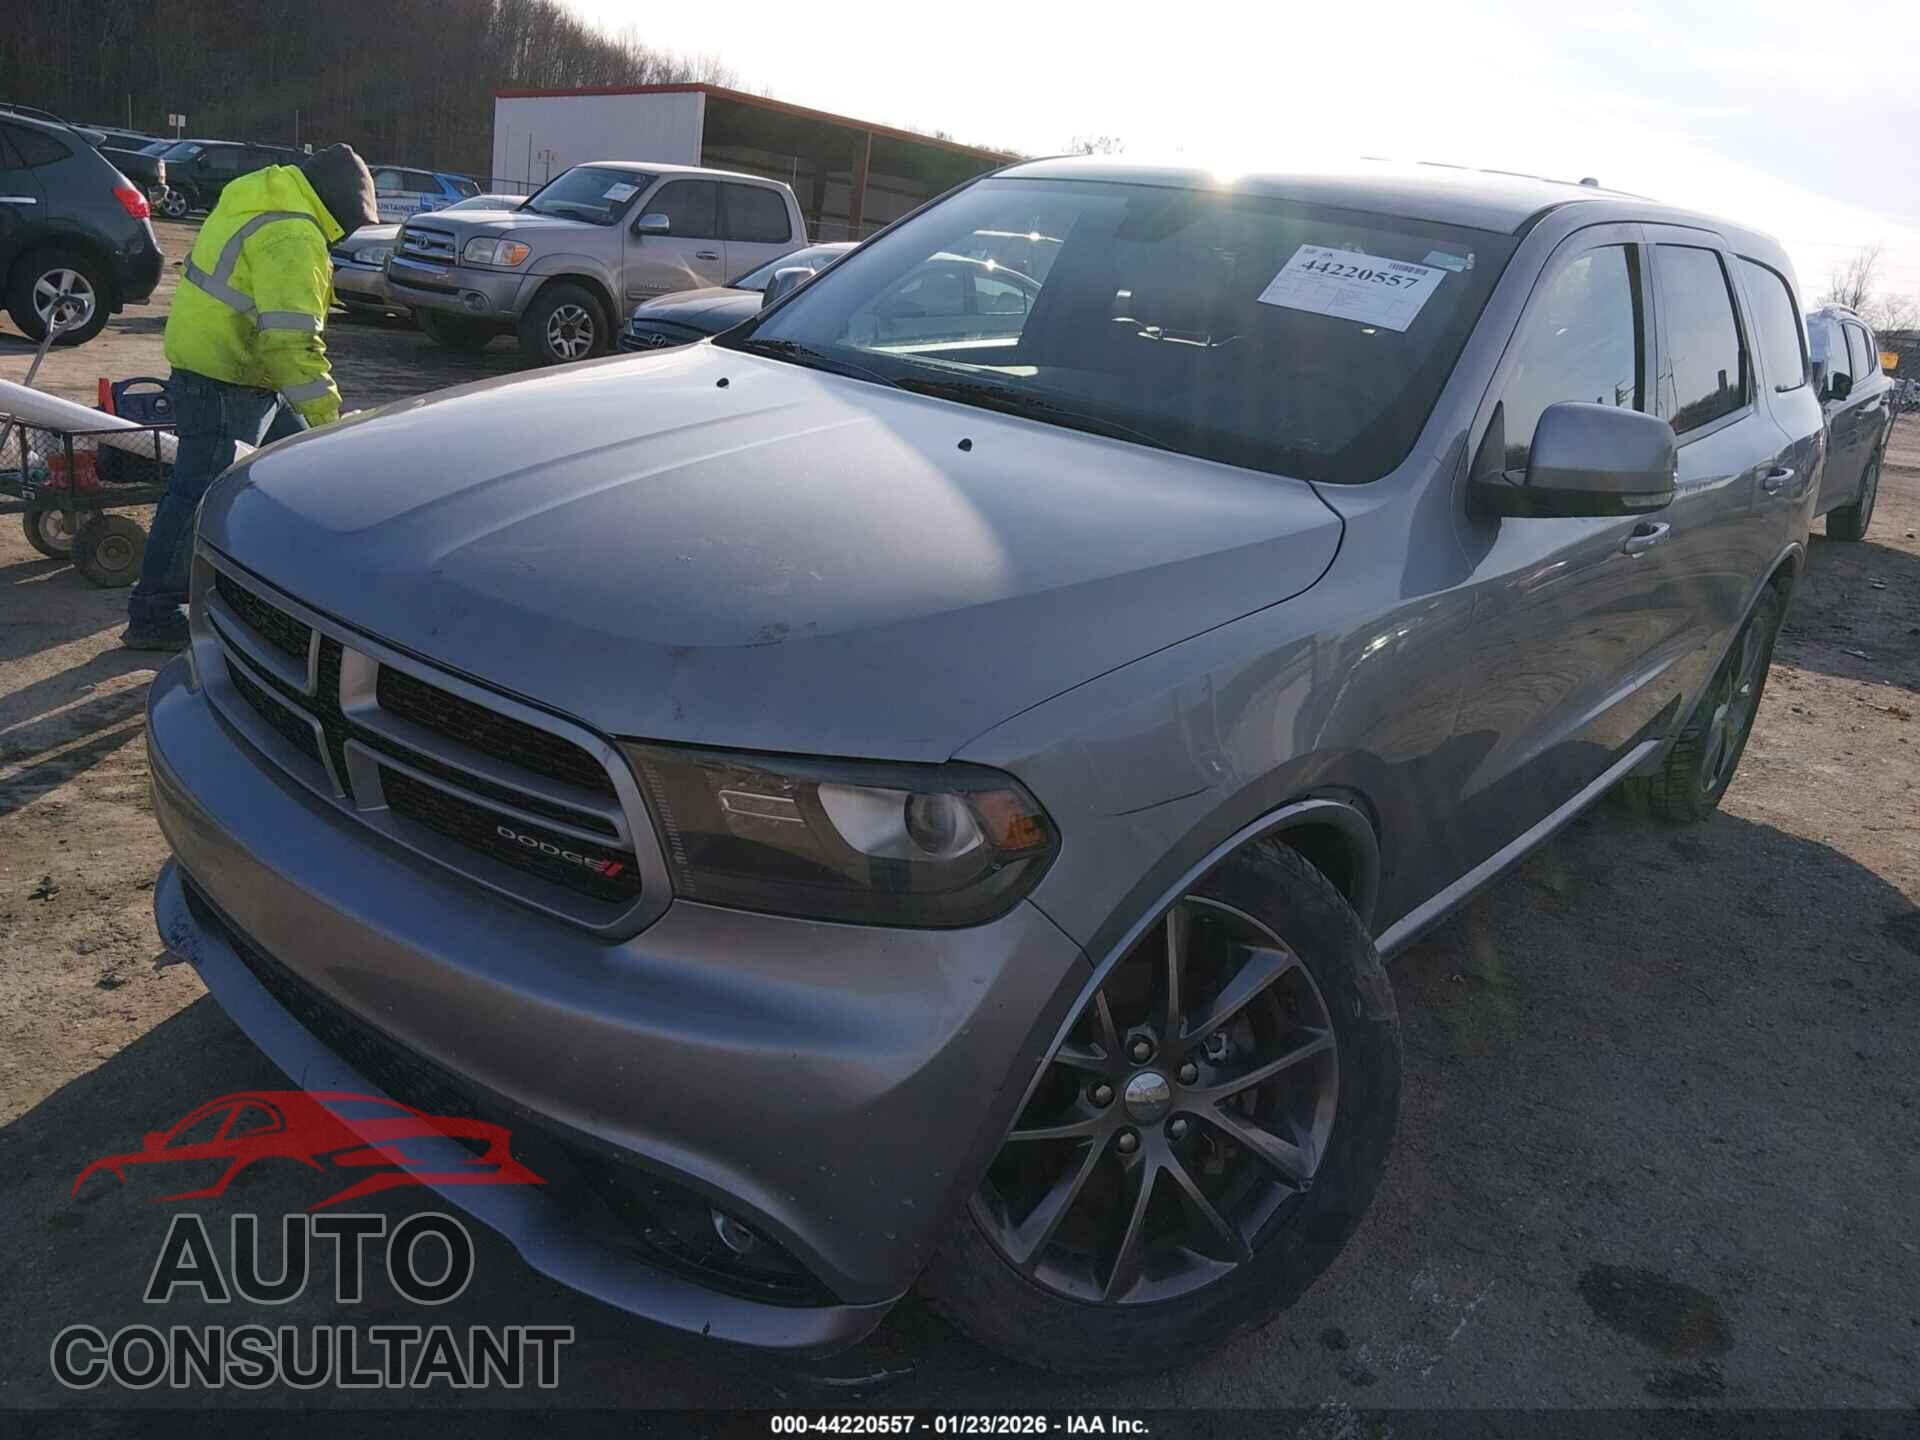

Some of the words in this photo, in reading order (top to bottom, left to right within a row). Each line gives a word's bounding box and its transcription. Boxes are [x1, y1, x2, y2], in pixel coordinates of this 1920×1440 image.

[377, 202, 421, 214] UNTAINEER
[1301, 259, 1419, 290] 44220557
[496, 825, 606, 873] DODGE
